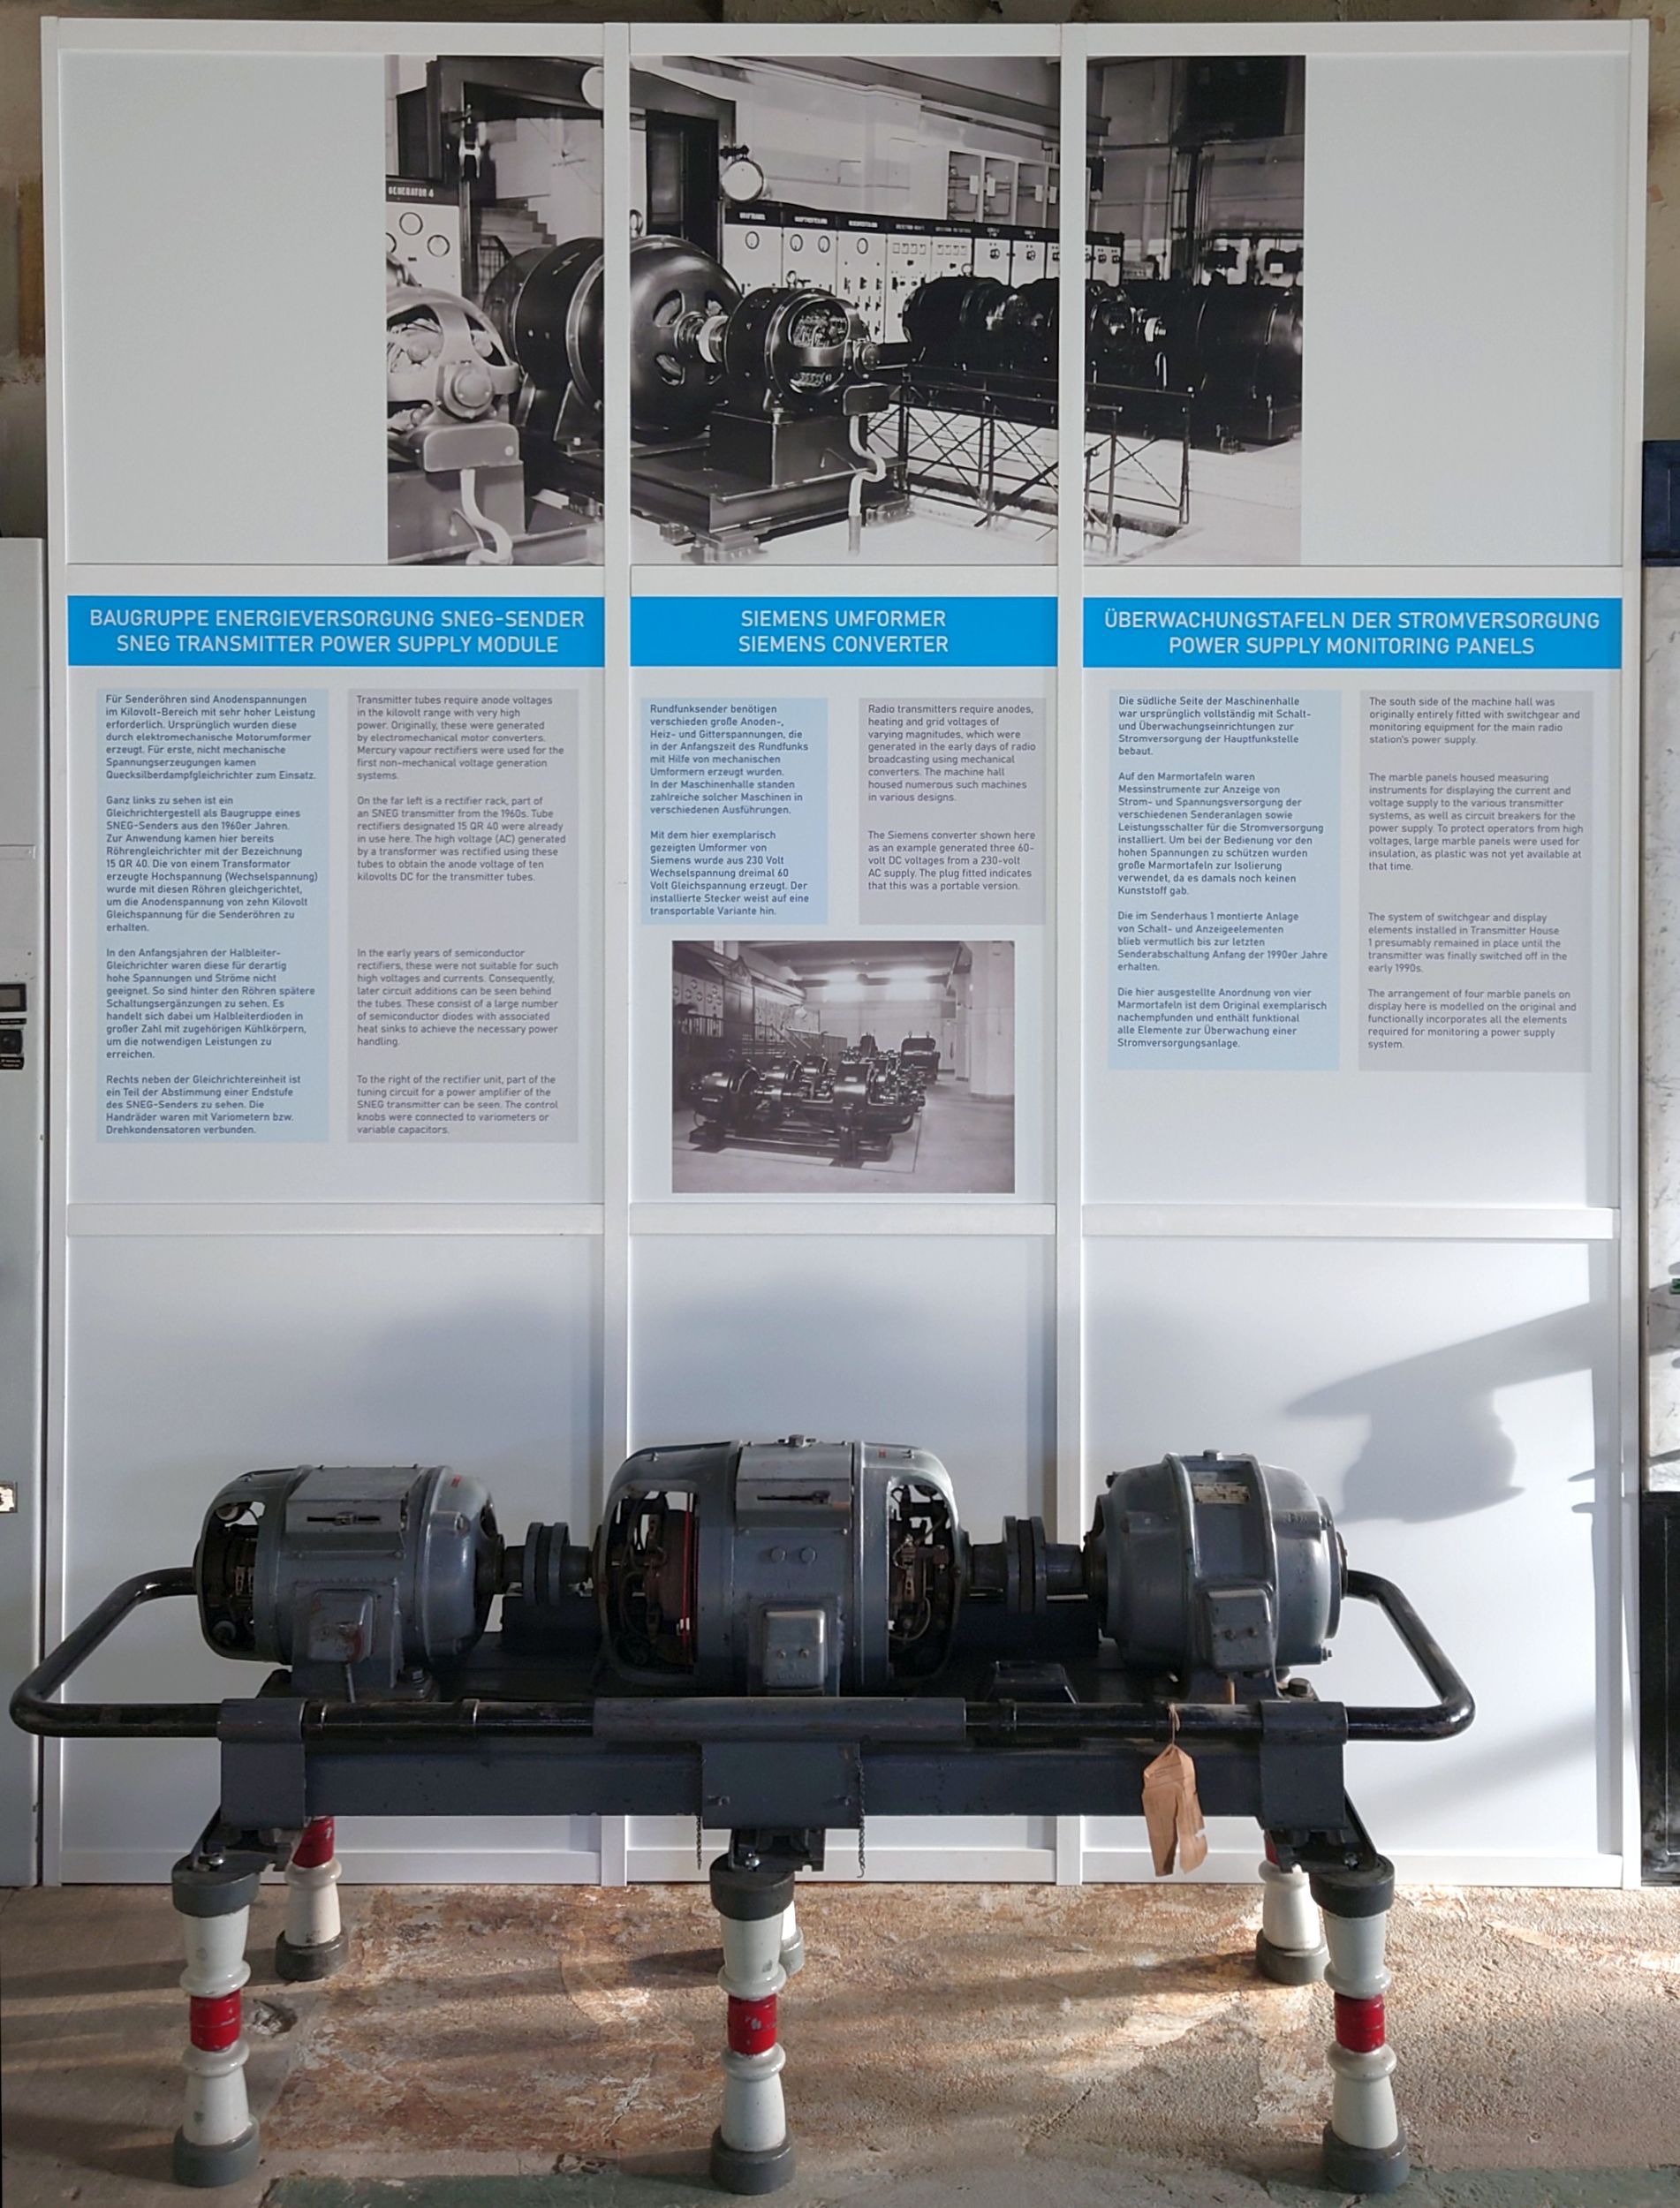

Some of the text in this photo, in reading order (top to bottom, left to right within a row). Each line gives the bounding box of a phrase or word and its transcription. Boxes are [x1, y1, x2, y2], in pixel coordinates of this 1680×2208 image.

[90, 609, 584, 627] BAUGRUPPE ENERGIEVERSORGUNG SNEG-SENDER
[741, 610, 946, 626] SIEMENS UMFORMER
[1105, 611, 1600, 629] ÜBERWACHUNGSTAFELN DER STROMVERSORGUNG
[117, 635, 558, 652] SNEG TRANSMITTER POWER SUPPLY MODULE
[738, 636, 948, 652] SIEMENS CONVERTER
[1169, 637, 1534, 654] POWER SUPPLY MONITORING PANELS
[105, 694, 306, 706] Für Senderöhren sind Anodenspannungen
[356, 695, 553, 707] Transmitter tubes require anode voltages
[1369, 697, 1387, 707] The
[1389, 697, 1416, 707] south
[1419, 697, 1439, 707] side
[1442, 697, 1450, 707] of
[1453, 697, 1469, 707] the
[1472, 697, 1512, 707] machine
[1515, 697, 1532, 707] hall
[105, 707, 315, 718] im Kilovolt-Bereich mit sehr hoher Leistung
[357, 707, 520, 719] in the kilovolt range with very high
[650, 704, 777, 715] Rundfunksender benötigen
[1369, 710, 1580, 721] originally entirely fitted with switchgear and
[105, 720, 297, 731] erforderlich. Ursprünglich wurden diese
[357, 722, 388, 731] power.
[391, 721, 438, 731] Originally,
[441, 721, 467, 730] these
[496, 721, 545, 731] generated
[649, 717, 783, 728] verschieden große Anoden-,
[1369, 722, 1563, 734] monitoring equipment for the main radio
[105, 732, 312, 742] durch elektromechanische Motorumformer
[357, 733, 545, 744] by electromechanical motor converters.
[650, 730, 803, 741] Heiz- und Gitterspannungen, die
[1369, 735, 1476, 746] station's power supply.
[650, 742, 808, 752] in der Anfangszeit des Rundfunks
[649, 754, 665, 764] mit
[668, 754, 690, 764] Hilfe
[712, 754, 781, 764] mechanischen
[650, 767, 784, 778] Umformern erzeugt wurden.
[650, 780, 795, 790] In der Maschinenhalle standen
[867, 830, 1035, 840] The Siemens converter shown here
[897, 843, 936, 854] example
[939, 843, 988, 854] generated
[990, 843, 1015, 852] three
[1018, 843, 1033, 852] 60-
[867, 856, 885, 866] volt
[889, 856, 902, 866] DC
[904, 856, 944, 867] voltages
[947, 856, 970, 866] from
[981, 856, 1020, 866] 230-volt
[1117, 911, 1299, 922] Die im Senderhaus 1 montierte Anlage
[1138, 924, 1171, 934] Schalt-
[1175, 924, 1192, 934] und
[1196, 924, 1284, 935] Anzeigeelementen
[1117, 936, 1140, 946] blieb
[1144, 936, 1194, 946] vermutlich
[1197, 936, 1211, 946] bis
[1232, 936, 1265, 946] letzten
[1117, 949, 1328, 961] Senderabschaltung Anfang der 1990er Jahre
[106, 1112, 156, 1122] Handräder
[193, 1112, 208, 1122] mit
[210, 1112, 270, 1122] Variometern
[273, 1112, 293, 1122] bzw.
[106, 1125, 256, 1135] Drehkondensatoren verbunden.
